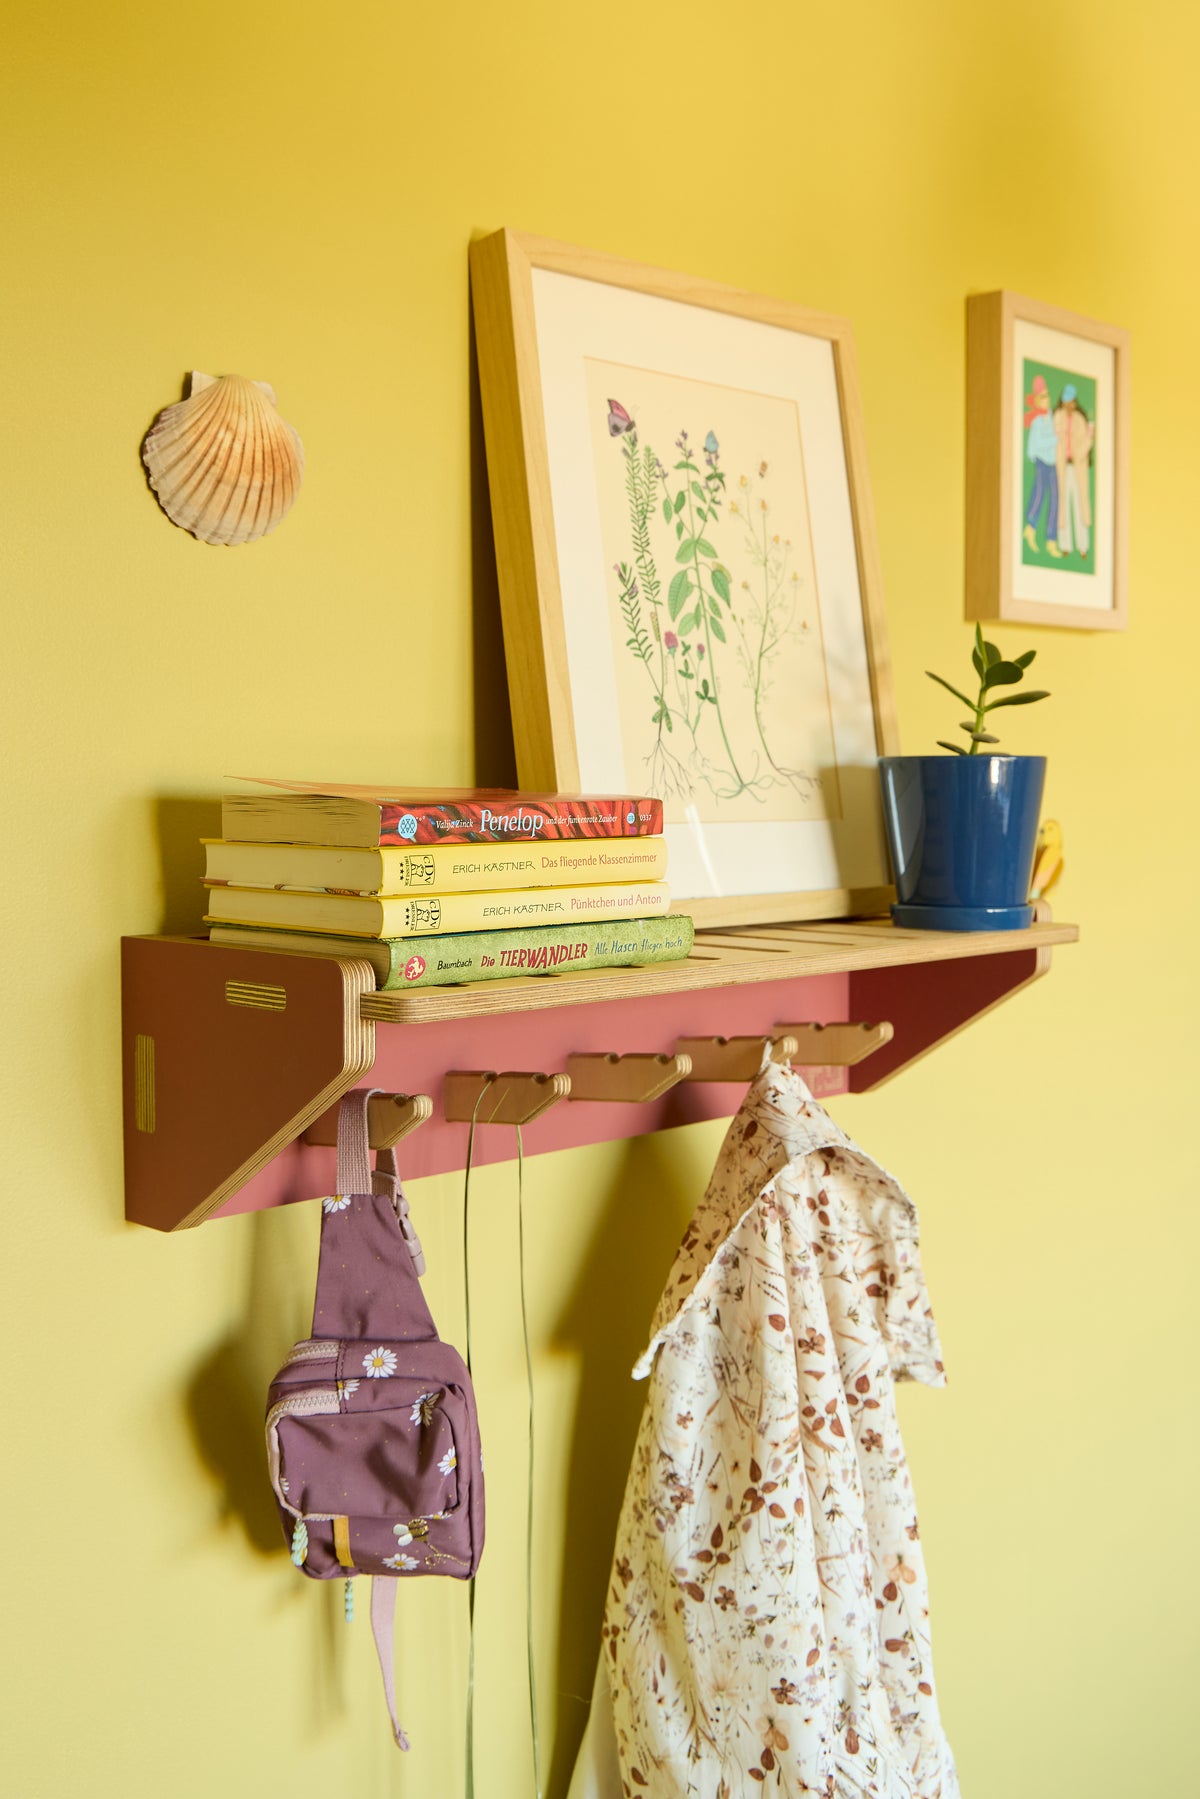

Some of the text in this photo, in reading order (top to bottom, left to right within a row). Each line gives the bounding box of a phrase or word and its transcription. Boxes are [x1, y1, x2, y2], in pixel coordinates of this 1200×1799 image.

[455, 819, 474, 829] Zinck
[479, 808, 543, 838] Penelop
[545, 814, 618, 826] und der funkenrote Zauber
[452, 860, 536, 874] ERICH KÄSTNER
[541, 853, 657, 869] Das fliegende Klassenzimmer
[482, 902, 565, 917] ERICH KÄSTNER
[570, 893, 662, 911] Pünktchen und Anton
[594, 936, 683, 955] Alle Hasen fliegen hoch
[480, 943, 588, 969] Die TIERWANDLER
[437, 957, 473, 971] Baumbach
